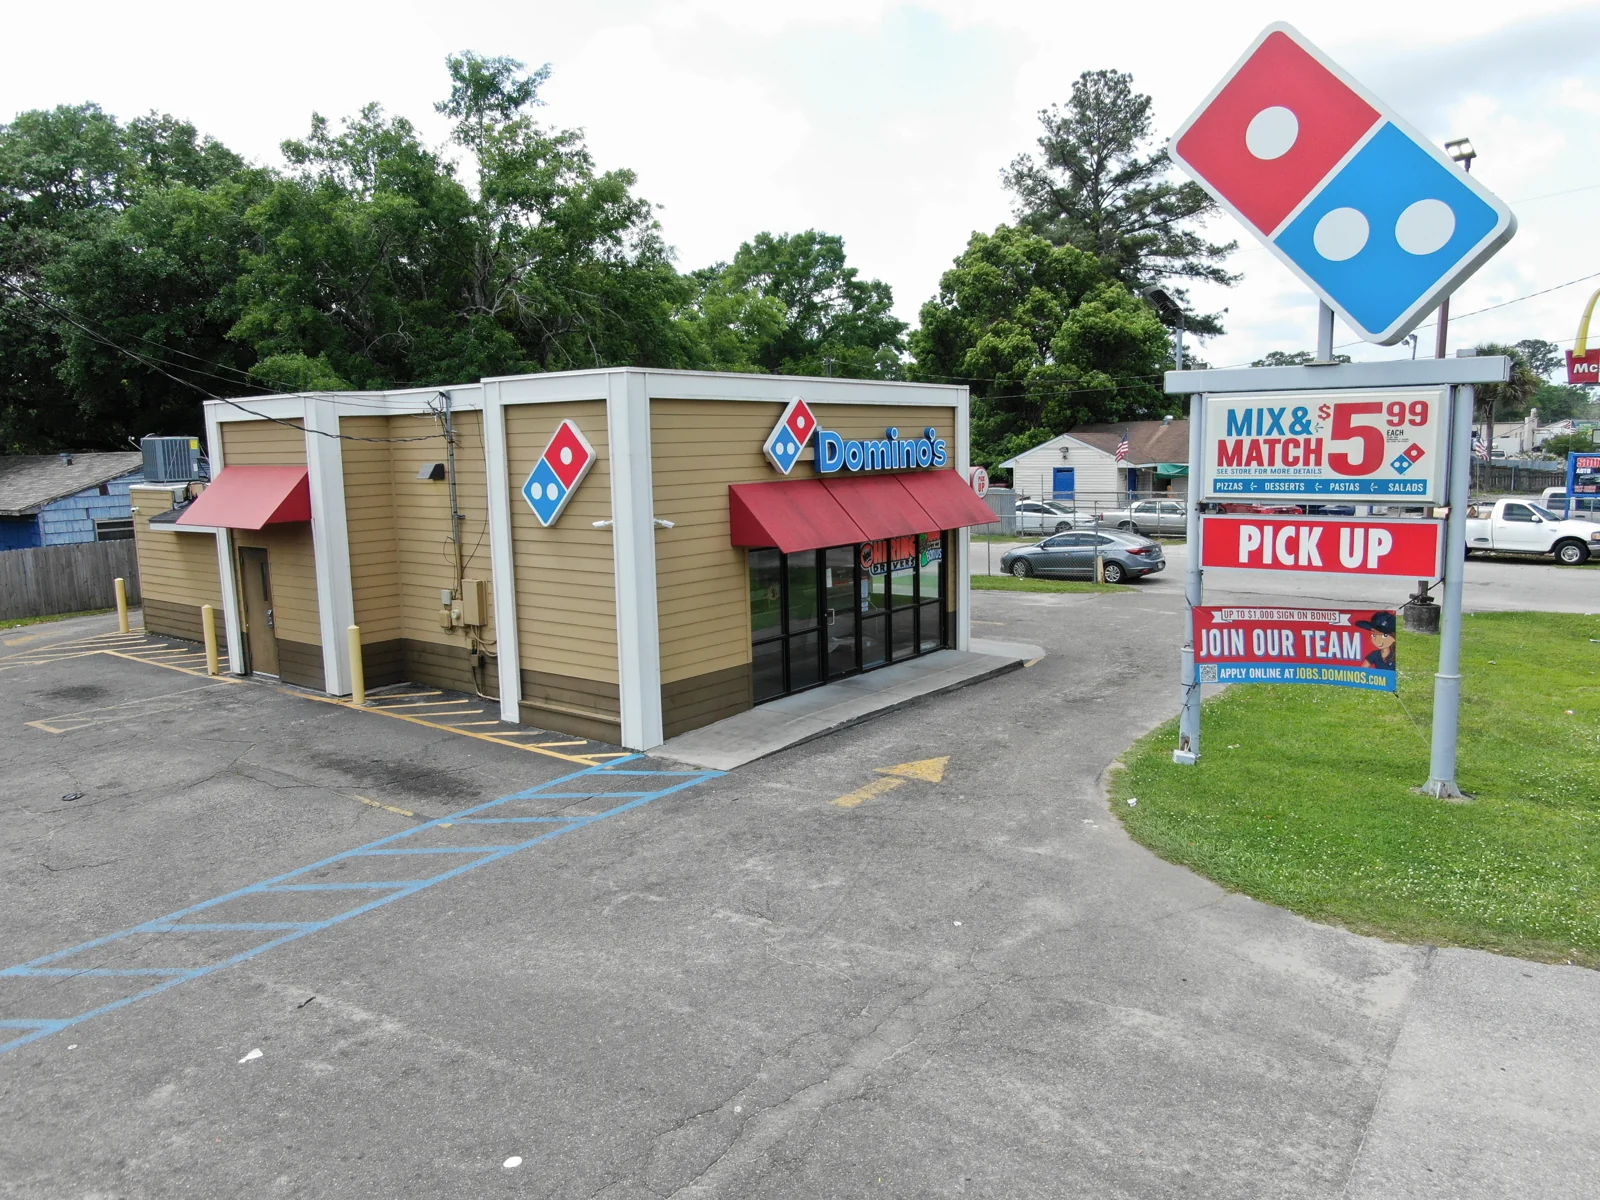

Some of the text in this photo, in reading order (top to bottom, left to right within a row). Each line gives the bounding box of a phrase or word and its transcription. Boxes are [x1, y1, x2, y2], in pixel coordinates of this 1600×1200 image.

[817, 427, 947, 473] Domino's
[1217, 438, 1323, 467] MATCH
[1216, 482, 1424, 492] PIZZAS DESSERTS PASTAS SALADS
[1239, 525, 1393, 569] PICK UP
[1224, 610, 1337, 621] UP TO $1,000 SIGN ON BONUS
[1200, 629, 1361, 660] JOIN OUR TEAM
[1220, 667, 1386, 687] APPLY ONLINE AT JOBS.DOMINOS.COM
